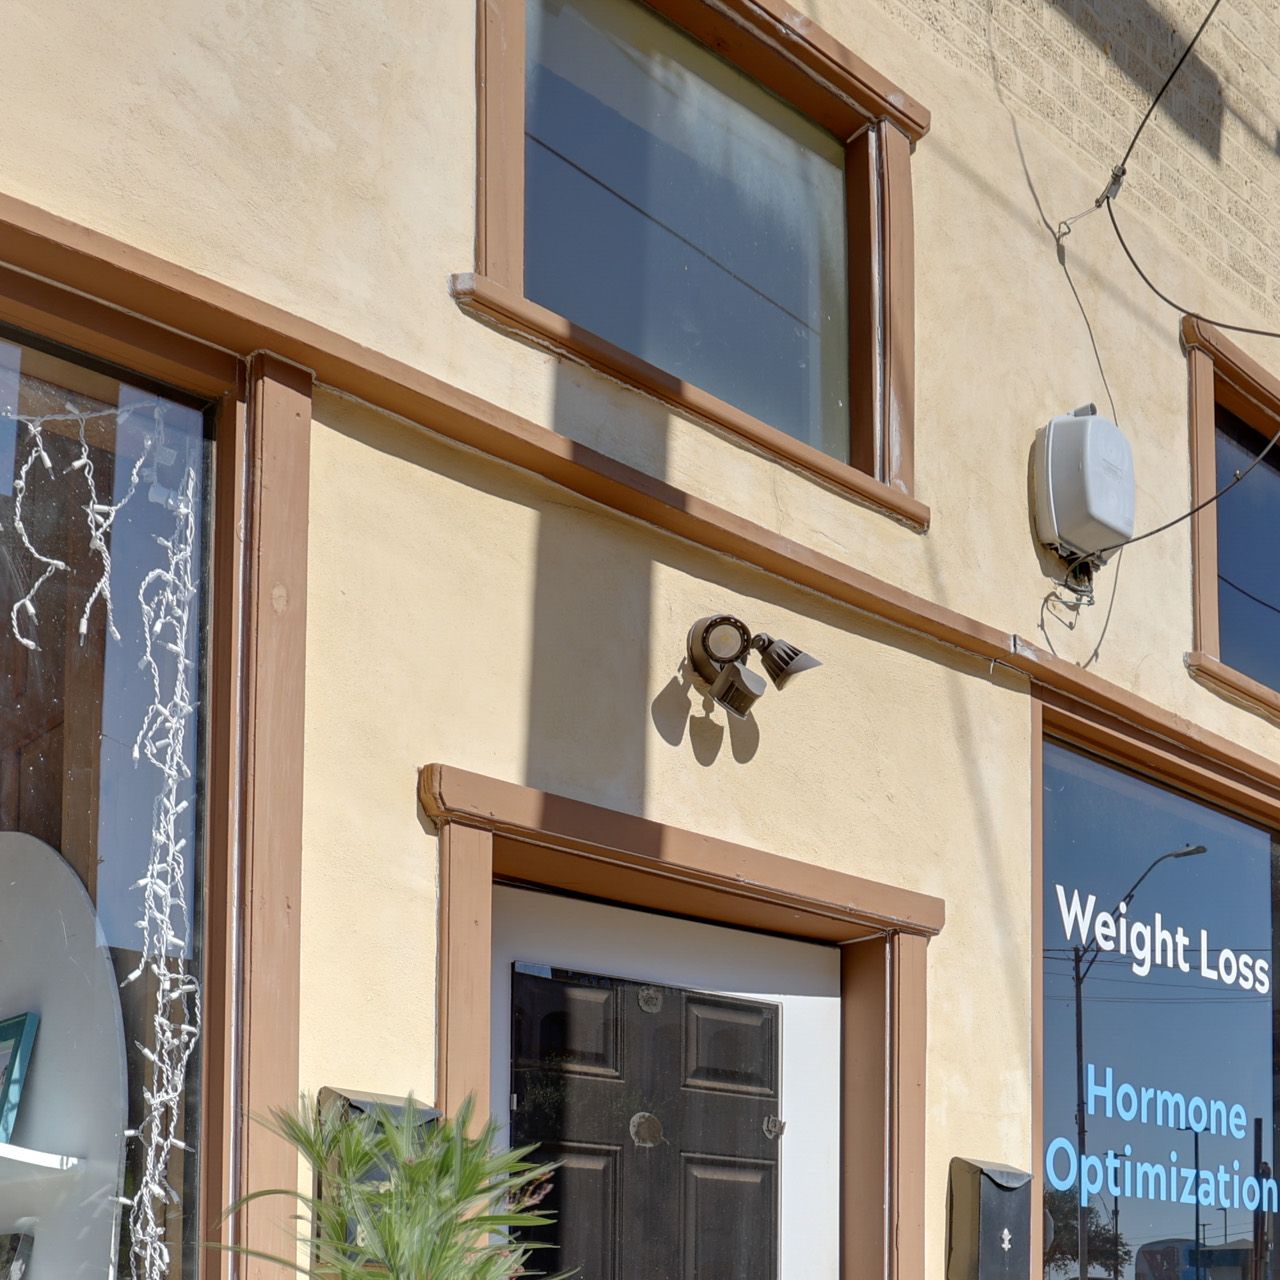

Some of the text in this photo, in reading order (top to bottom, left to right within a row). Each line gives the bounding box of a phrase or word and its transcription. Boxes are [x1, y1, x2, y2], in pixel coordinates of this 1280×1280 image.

[1055, 884, 1270, 995] Weight Loss
[1087, 1063, 1247, 1140] Hormone
[1045, 1136, 1279, 1213] Optimization
